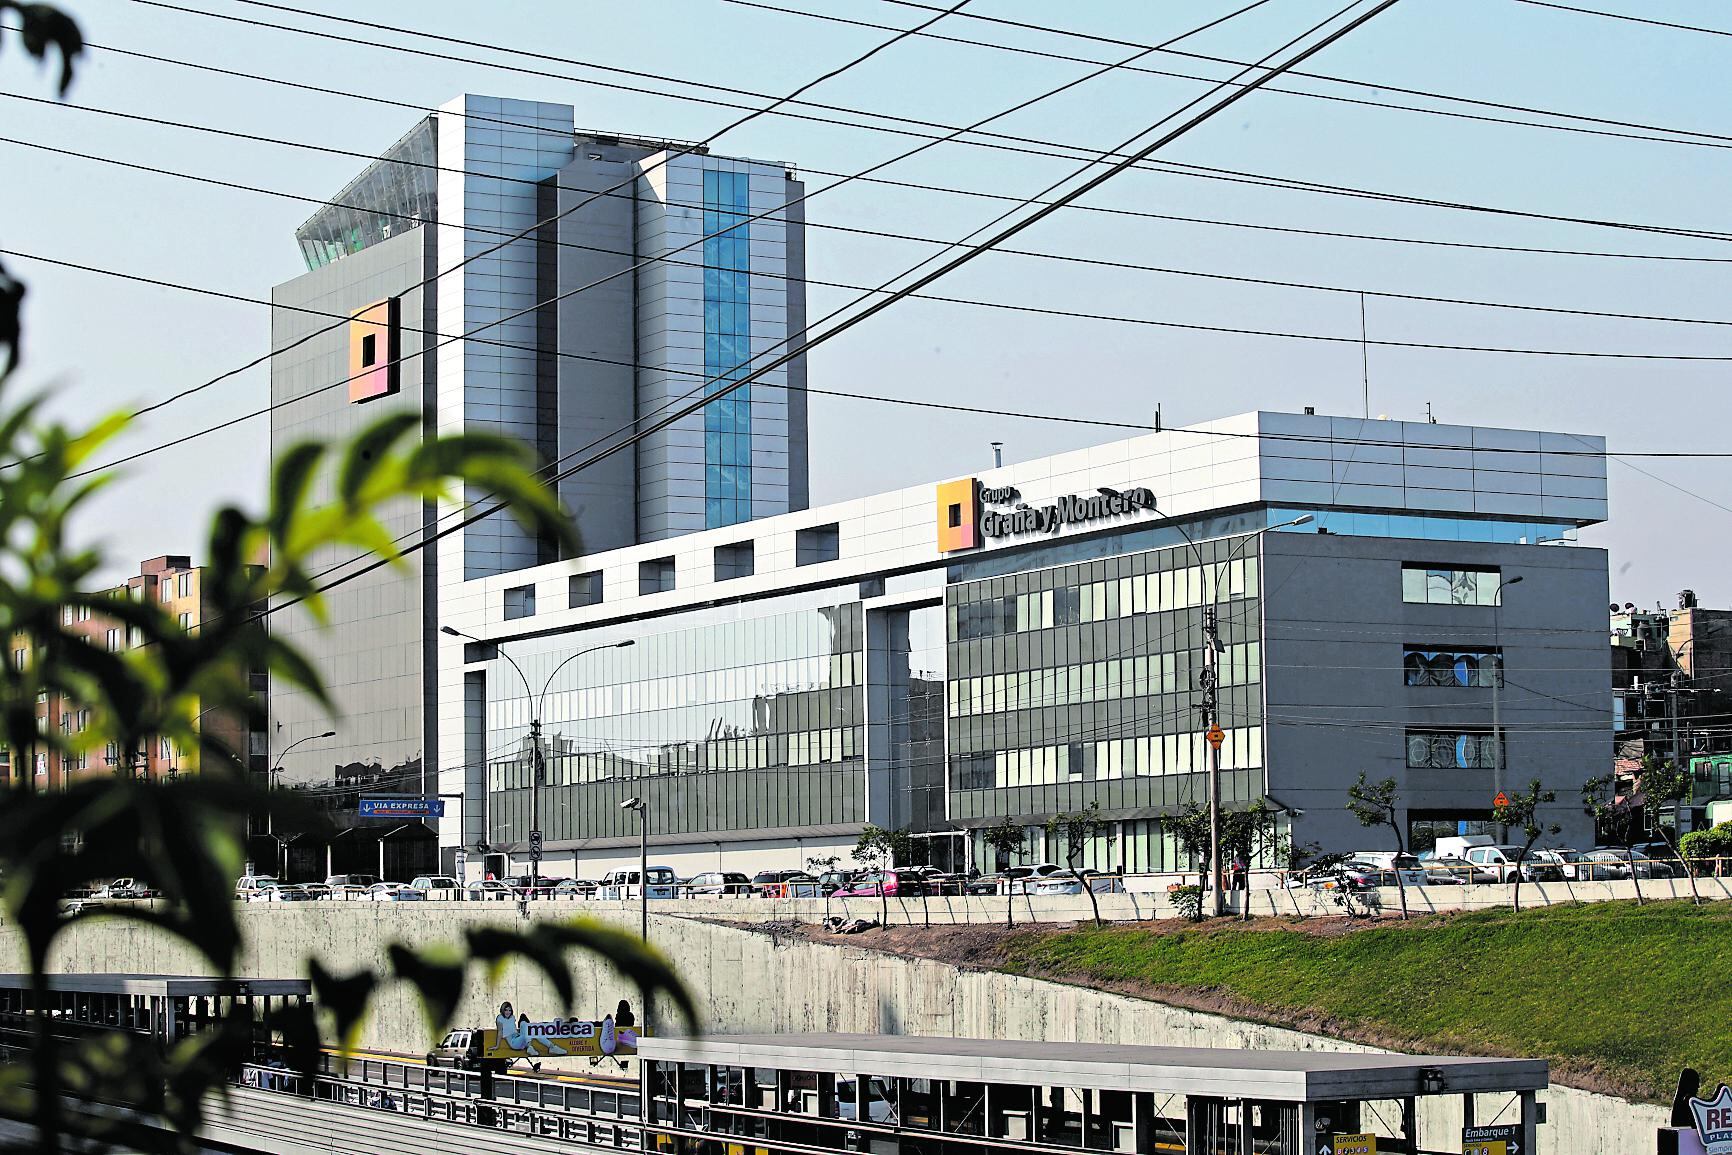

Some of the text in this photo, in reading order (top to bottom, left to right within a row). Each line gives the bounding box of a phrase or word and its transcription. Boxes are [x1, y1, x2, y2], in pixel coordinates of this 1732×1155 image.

[980, 486, 1011, 504] Grupo
[980, 487, 1146, 538] Graña y Montero
[527, 1020, 592, 1036] moleca
[1336, 1135, 1367, 1143] SERVICIOS
[1465, 1126, 1516, 1138] Embarque 1
[1709, 1132, 1732, 1141] PLA
